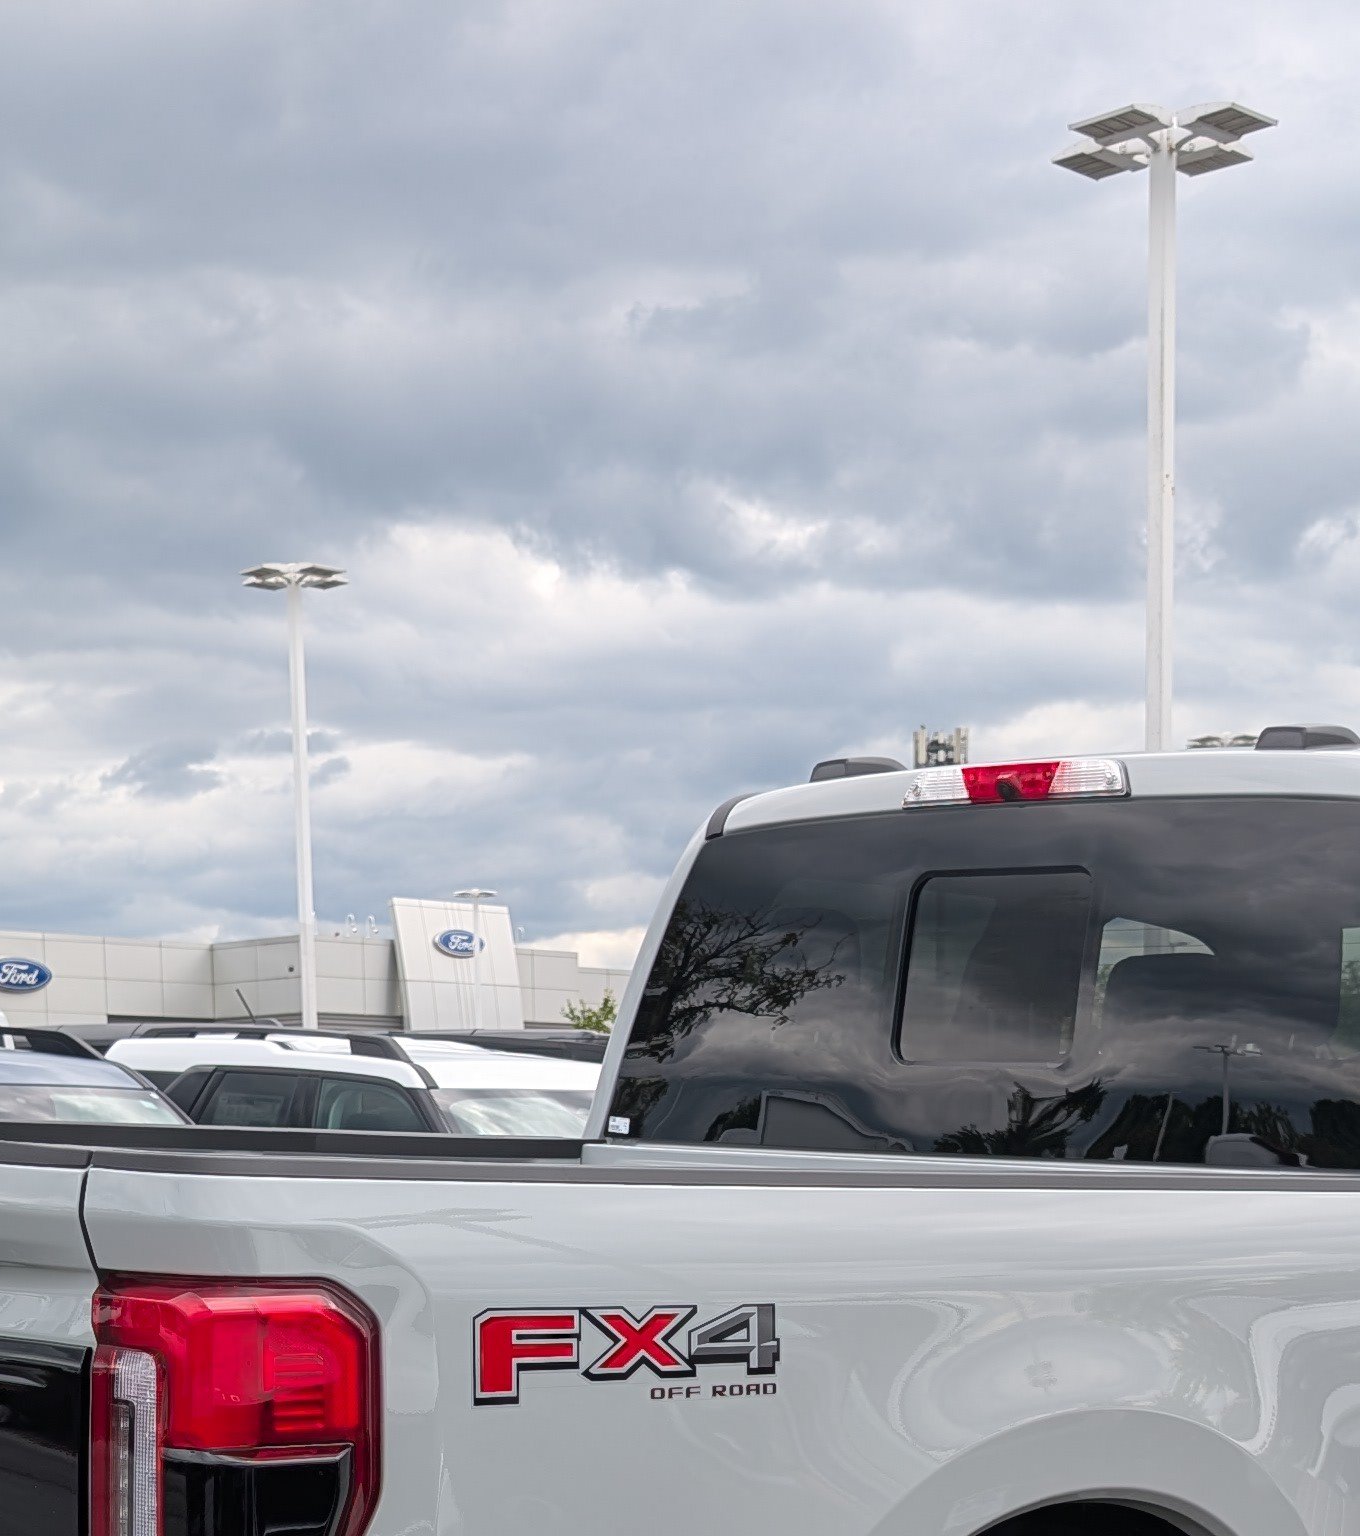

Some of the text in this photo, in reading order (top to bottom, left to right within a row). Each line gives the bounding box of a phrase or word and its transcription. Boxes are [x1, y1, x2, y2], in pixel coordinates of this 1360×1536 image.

[472, 1302, 781, 1407] FX4
[650, 1382, 778, 1401] OFF ROAD
